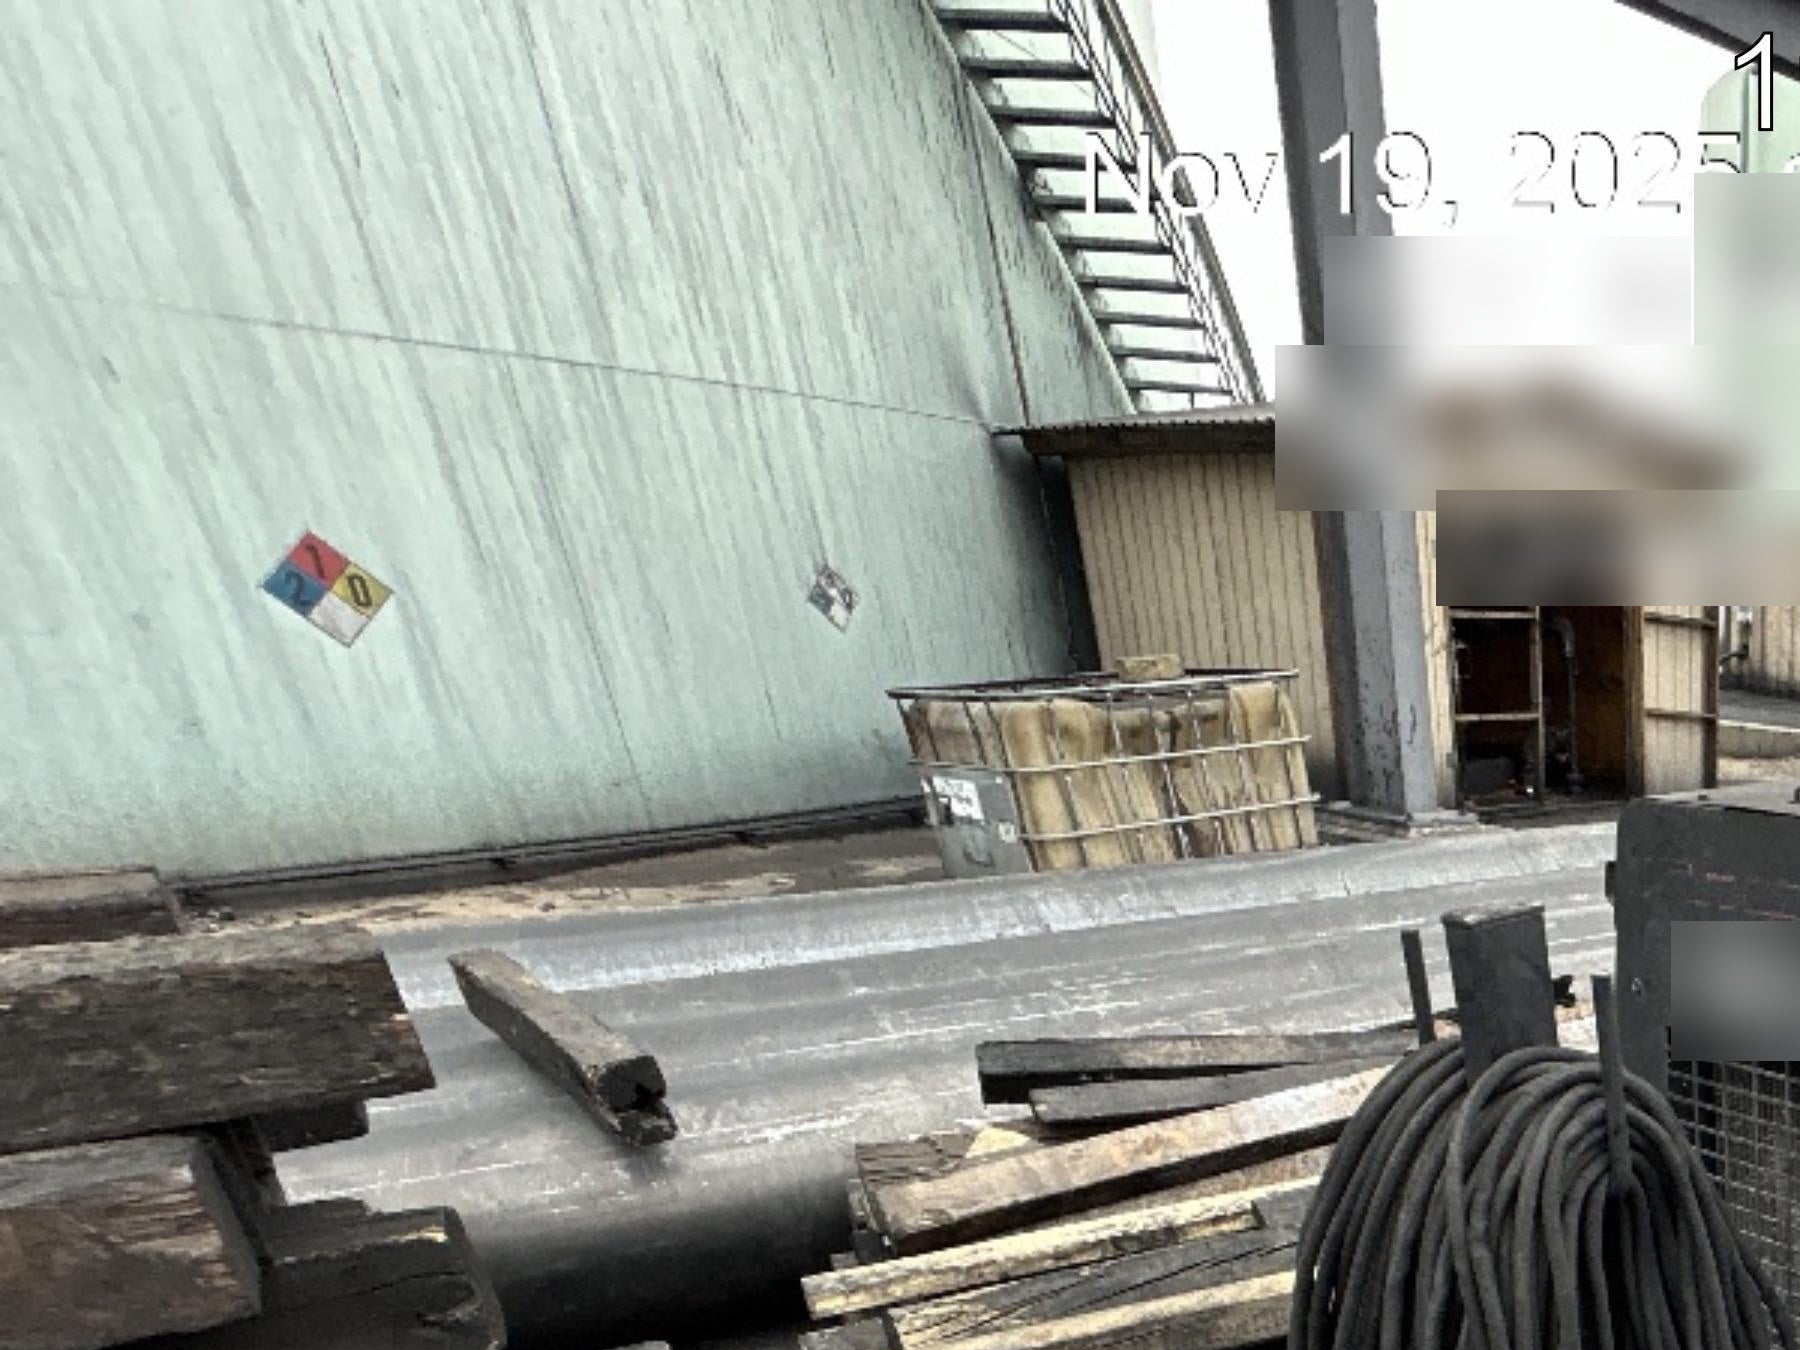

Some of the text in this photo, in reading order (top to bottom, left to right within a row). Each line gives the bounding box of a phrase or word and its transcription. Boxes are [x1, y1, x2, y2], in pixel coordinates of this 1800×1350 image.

[305, 543, 327, 580] 1
[284, 571, 314, 607] 2
[346, 572, 374, 607] 0
